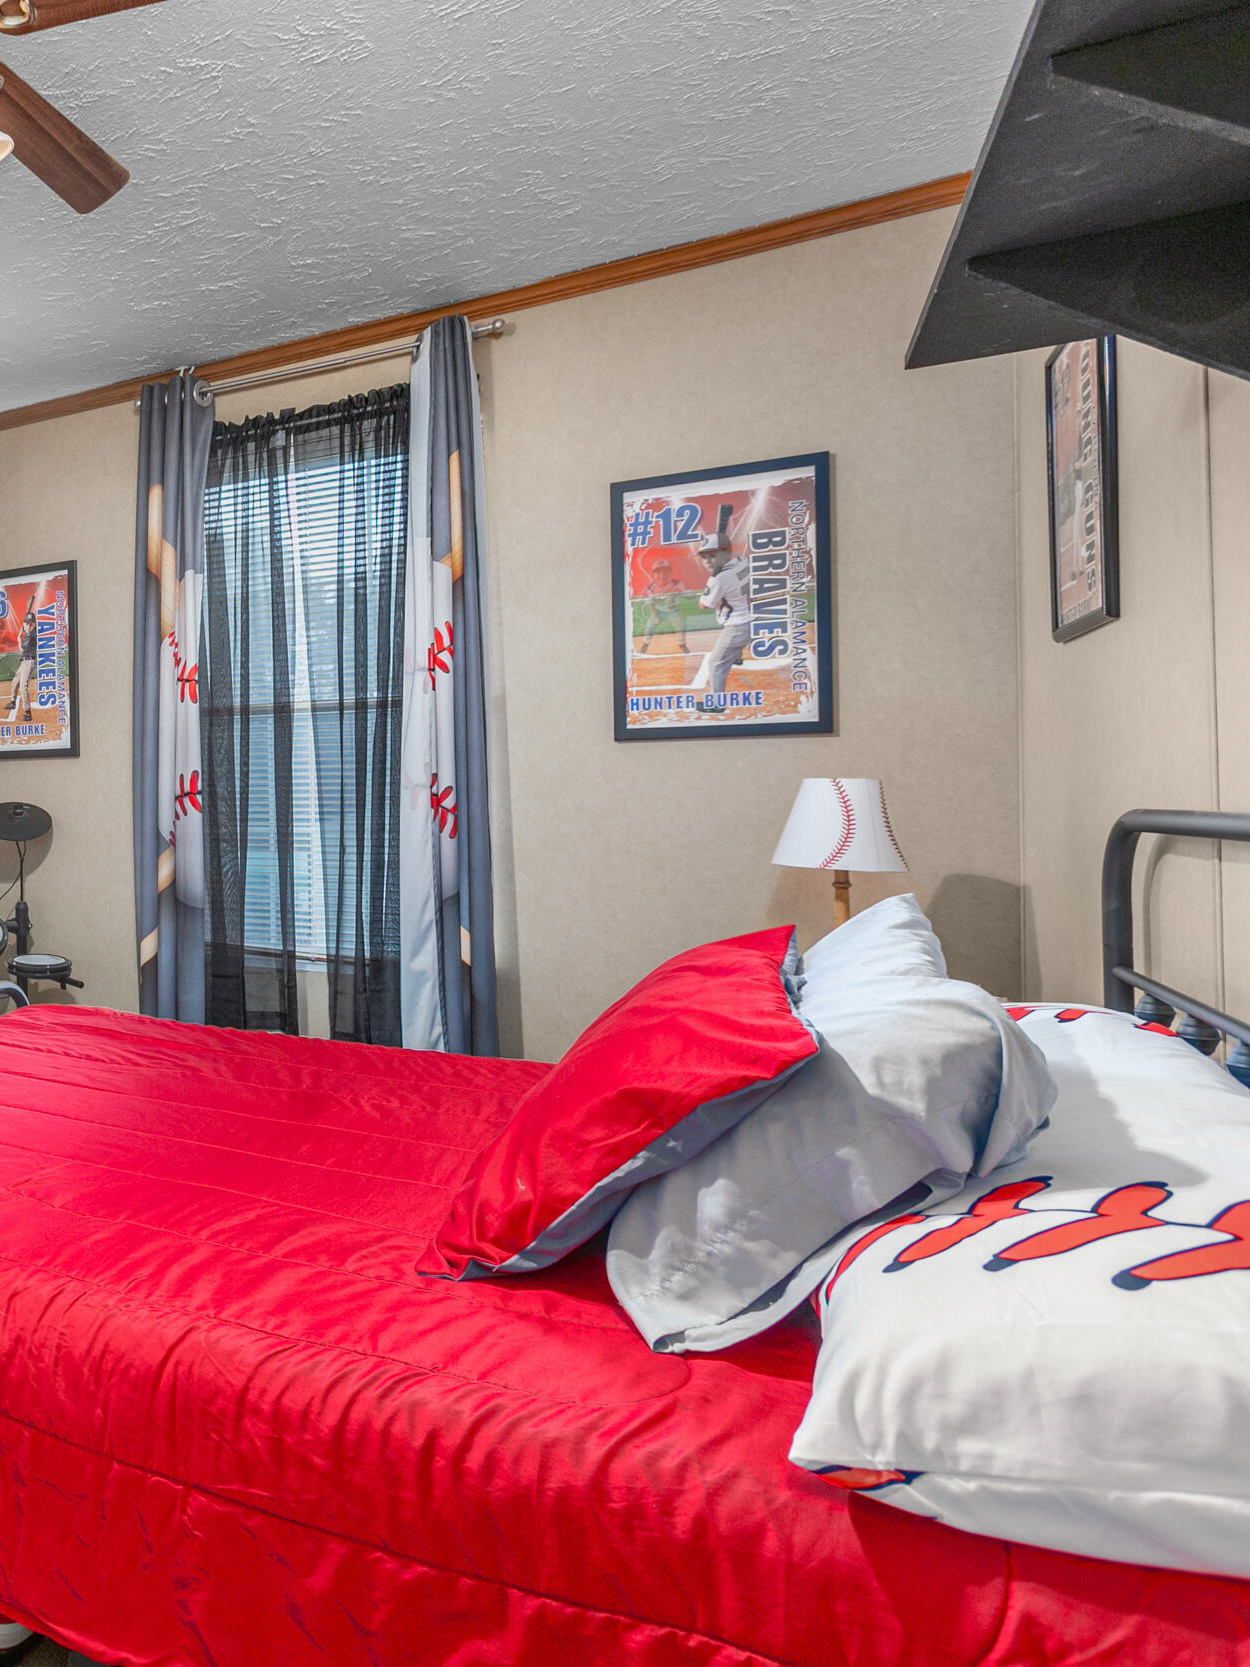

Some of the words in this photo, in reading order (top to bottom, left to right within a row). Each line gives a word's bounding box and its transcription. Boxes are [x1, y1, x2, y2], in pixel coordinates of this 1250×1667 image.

[1078, 349, 1094, 464] OUNG
[627, 503, 701, 548] #12
[788, 499, 807, 594] NORTHERN
[55, 590, 65, 656] NORTHERN
[750, 527, 790, 660] BRAVES
[37, 604, 57, 707] YANKEES
[789, 598, 809, 692] ALAMANCE
[15, 724, 45, 736] BURKE
[57, 659, 67, 725] ALAMANCE
[630, 694, 695, 712] HUNTER
[704, 690, 763, 708] BURKE
